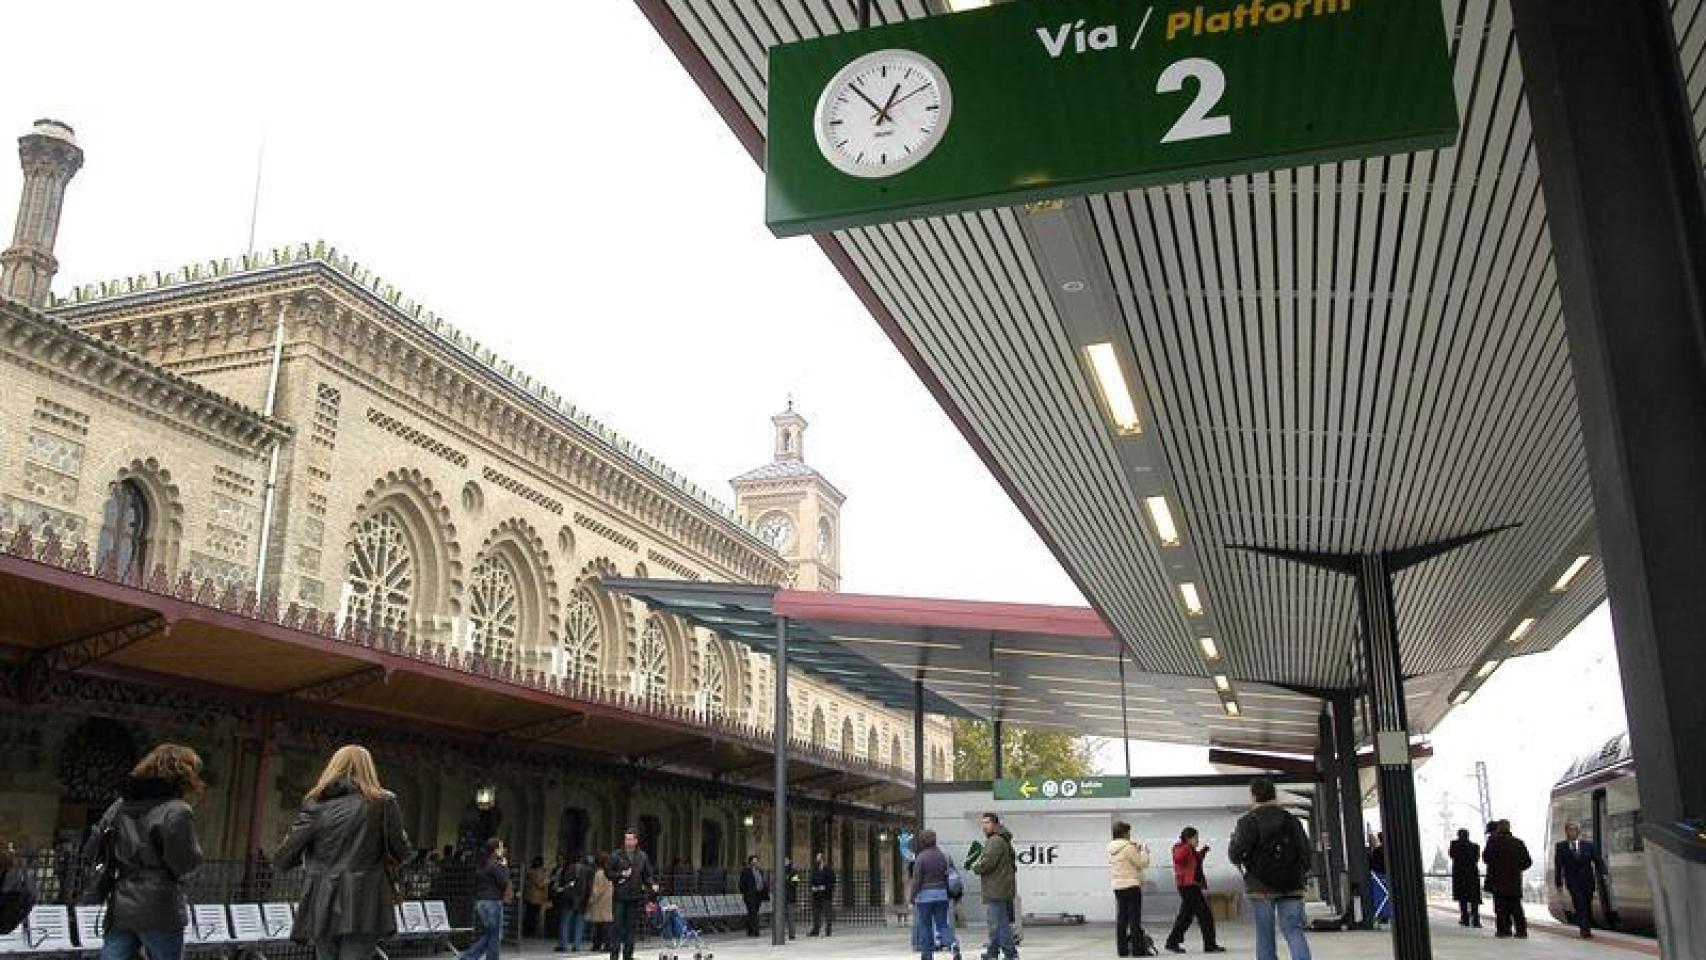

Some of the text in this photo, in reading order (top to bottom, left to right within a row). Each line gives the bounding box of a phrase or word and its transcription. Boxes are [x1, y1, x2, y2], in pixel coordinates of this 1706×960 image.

[1036, 19, 1118, 58] Vía
[1130, 6, 1153, 50] /
[1156, 58, 1231, 143] 2
[1017, 845, 1059, 865] dif
